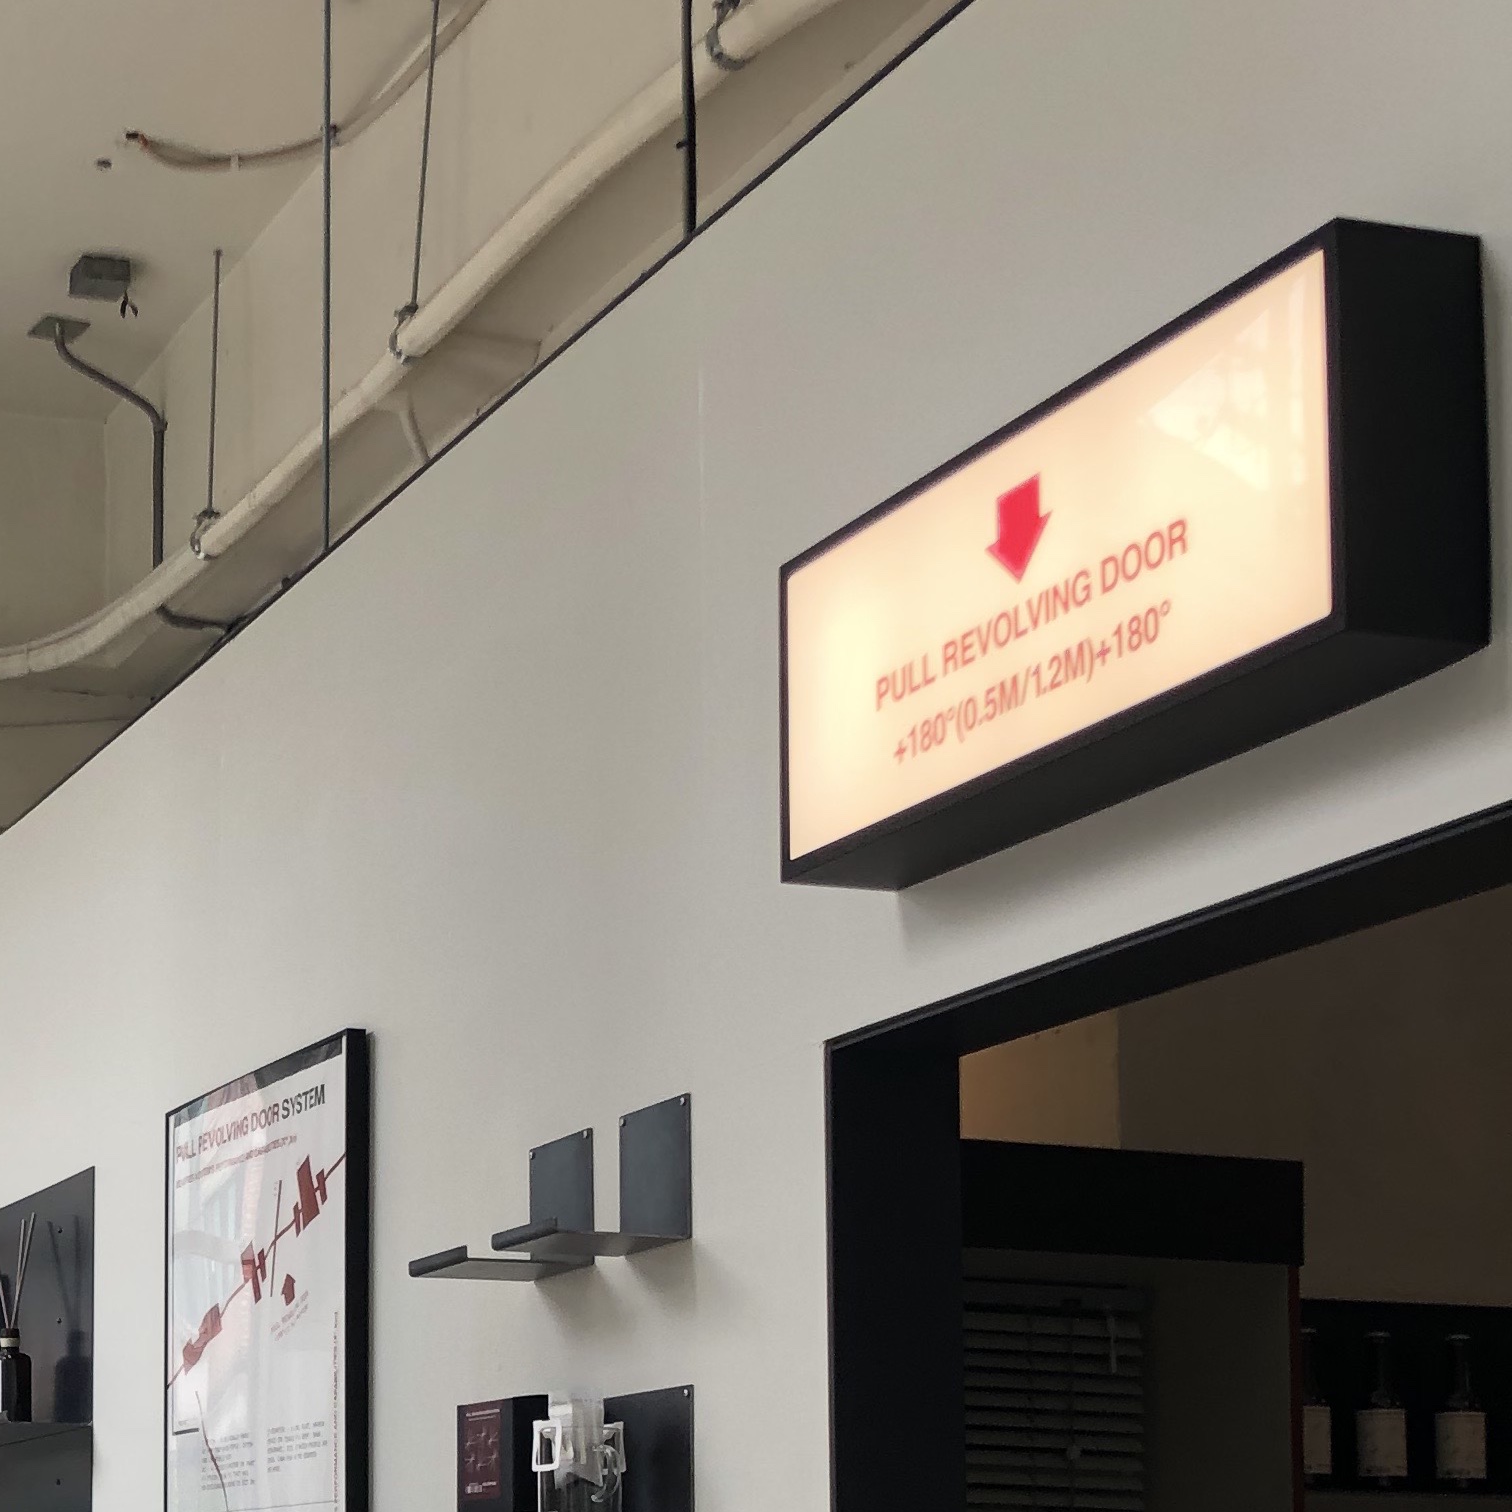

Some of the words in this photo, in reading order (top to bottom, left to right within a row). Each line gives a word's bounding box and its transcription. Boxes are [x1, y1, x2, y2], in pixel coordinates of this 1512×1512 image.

[875, 653, 937, 712] PULL
[941, 568, 1092, 678] REVOLVING
[1100, 518, 1188, 595] DOOR
[251, 1103, 280, 1132] DOOR
[281, 1084, 326, 1119] SYSTEM
